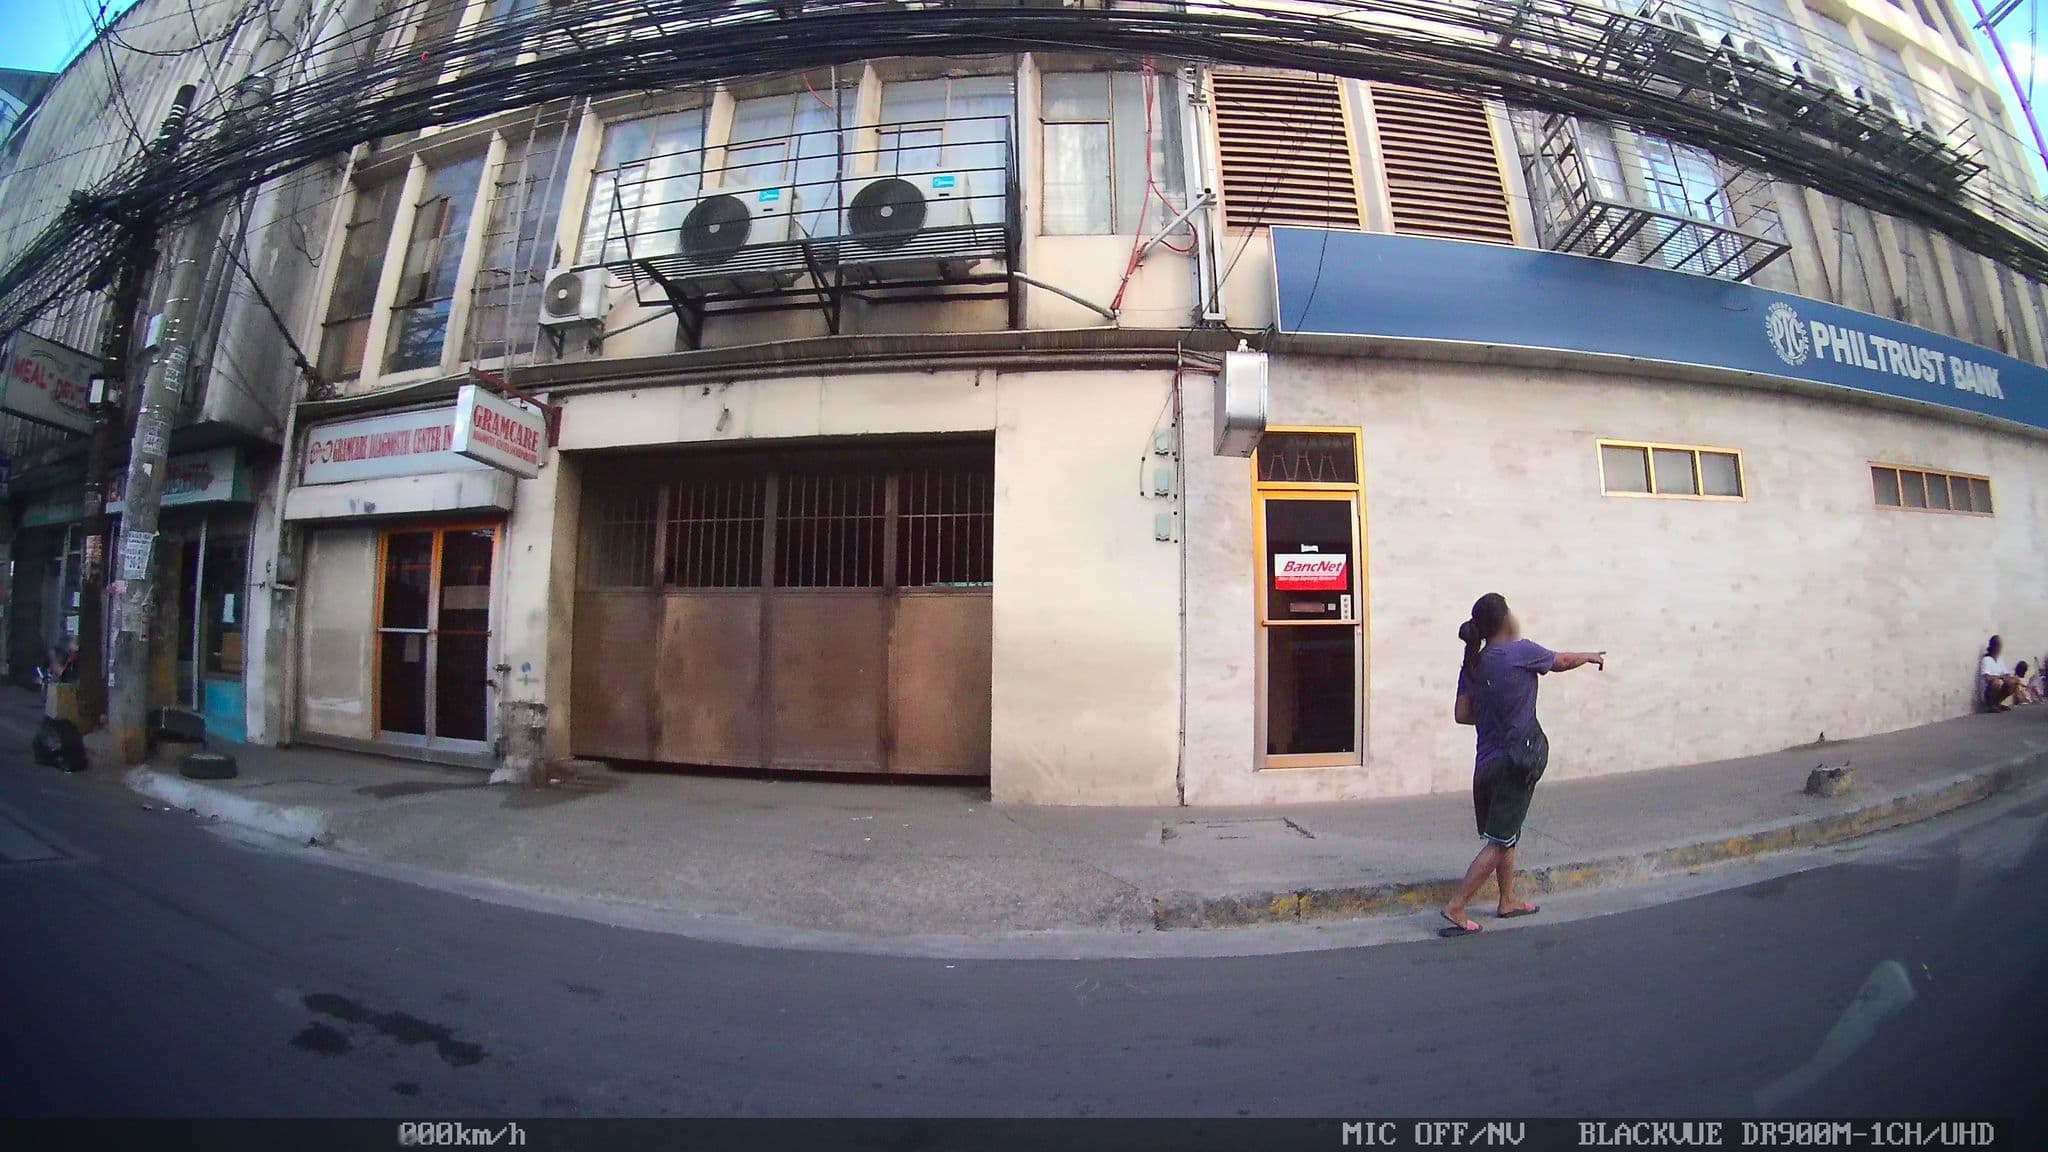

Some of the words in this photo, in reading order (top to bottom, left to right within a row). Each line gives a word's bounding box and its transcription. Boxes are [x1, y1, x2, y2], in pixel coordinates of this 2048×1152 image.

[1809, 320, 1946, 386] PHILTRUST
[1949, 354, 2005, 400] BANK
[413, 425, 442, 454] CENTER
[473, 404, 540, 453] GRAMCARE
[1282, 560, 1343, 573] BancNet
